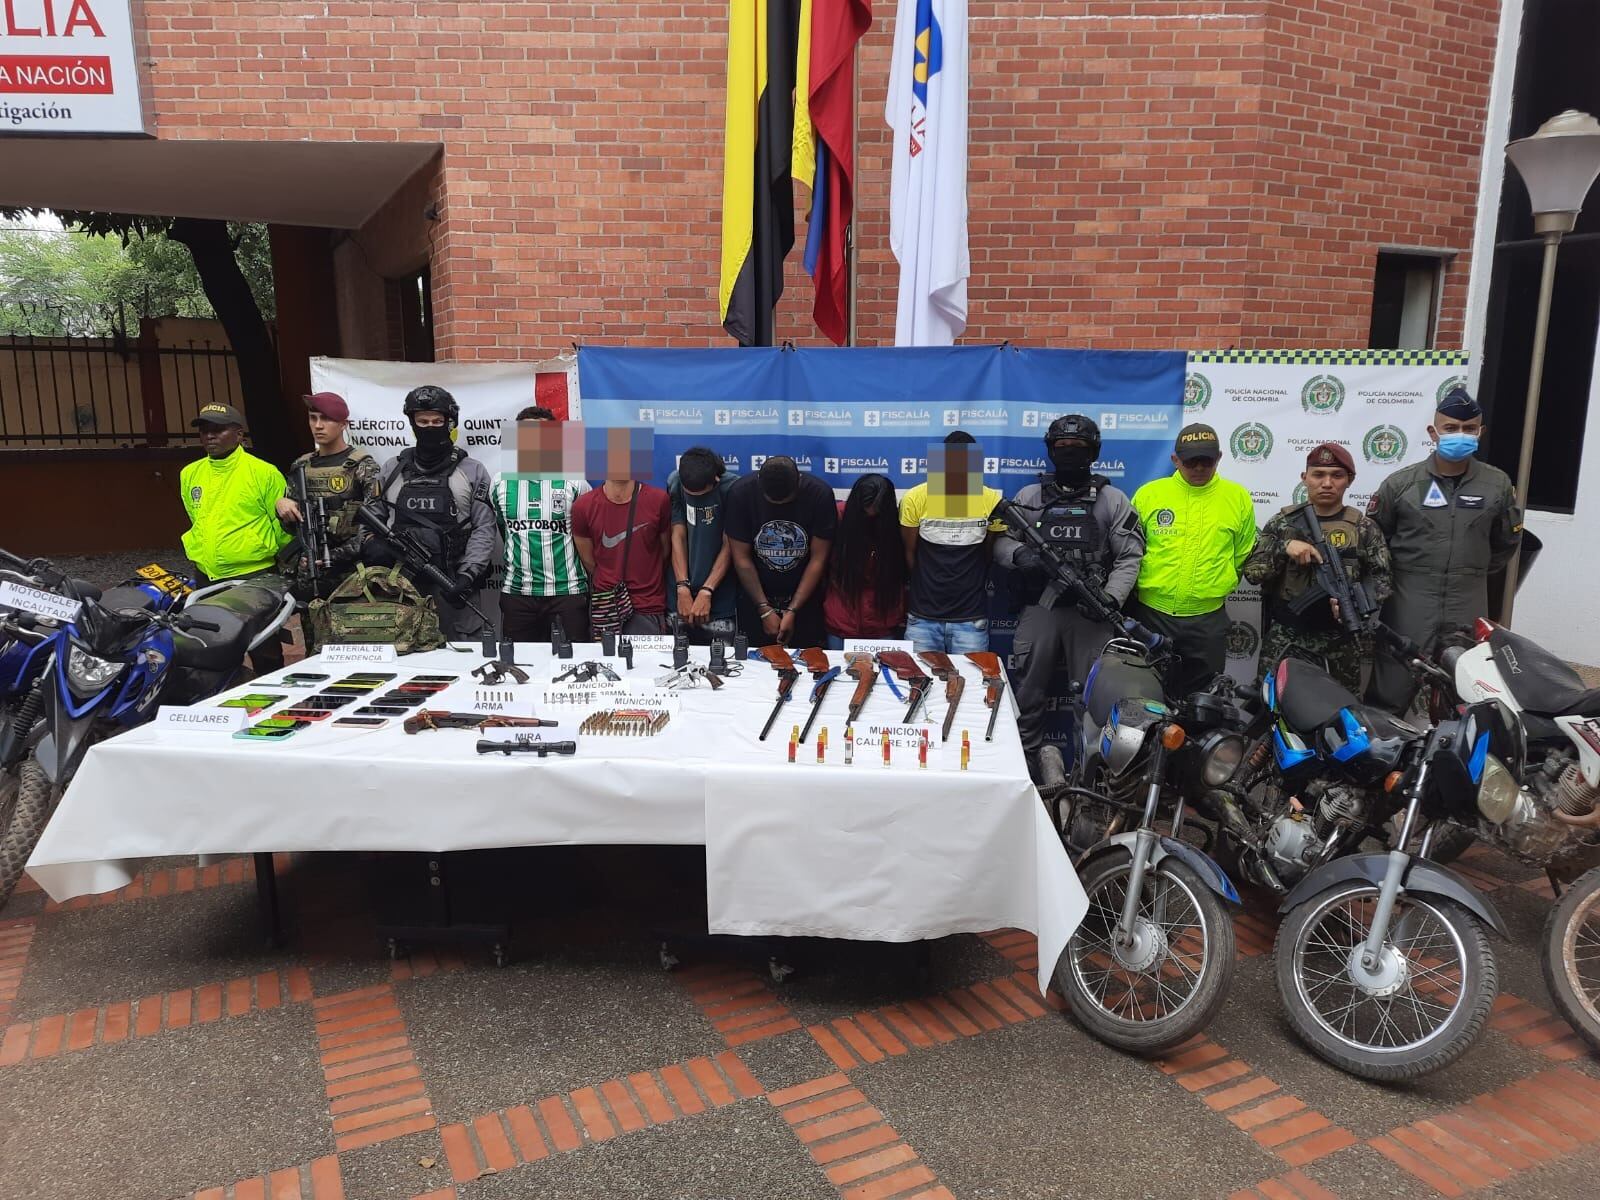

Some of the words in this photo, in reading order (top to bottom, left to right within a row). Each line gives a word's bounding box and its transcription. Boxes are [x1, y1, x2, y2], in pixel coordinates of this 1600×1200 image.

[16, 60, 105, 86] NACIÓN
[656, 408, 702, 417] FISCALÍA
[732, 408, 779, 417] FISCALÍA
[805, 409, 852, 419] FISCALÍA
[882, 409, 930, 419] FISCALÍA
[961, 408, 1008, 418] FISCALÍA
[1120, 413, 1169, 423] FISCALÍA
[349, 417, 405, 431] EJÉRCITO
[464, 418, 506, 431] QUINT
[351, 435, 410, 447] NACIONAL
[841, 457, 888, 466] FISCALÍA
[1001, 458, 1047, 467] FISCALÍA
[1091, 460, 1126, 470] CALÍA
[406, 498, 435, 510] CTI
[1050, 525, 1082, 538] CTI
[11, 597, 75, 620] INCAUTADA
[329, 645, 370, 653] MATERIAL
[372, 645, 384, 653] DE
[853, 645, 902, 653] ESCOPETAS
[326, 654, 382, 662] INTENDENCIA
[474, 702, 504, 711] ARMA
[169, 713, 230, 724] CELULARES
[515, 732, 542, 742] MIRA
[856, 737, 902, 748] CALIRE
